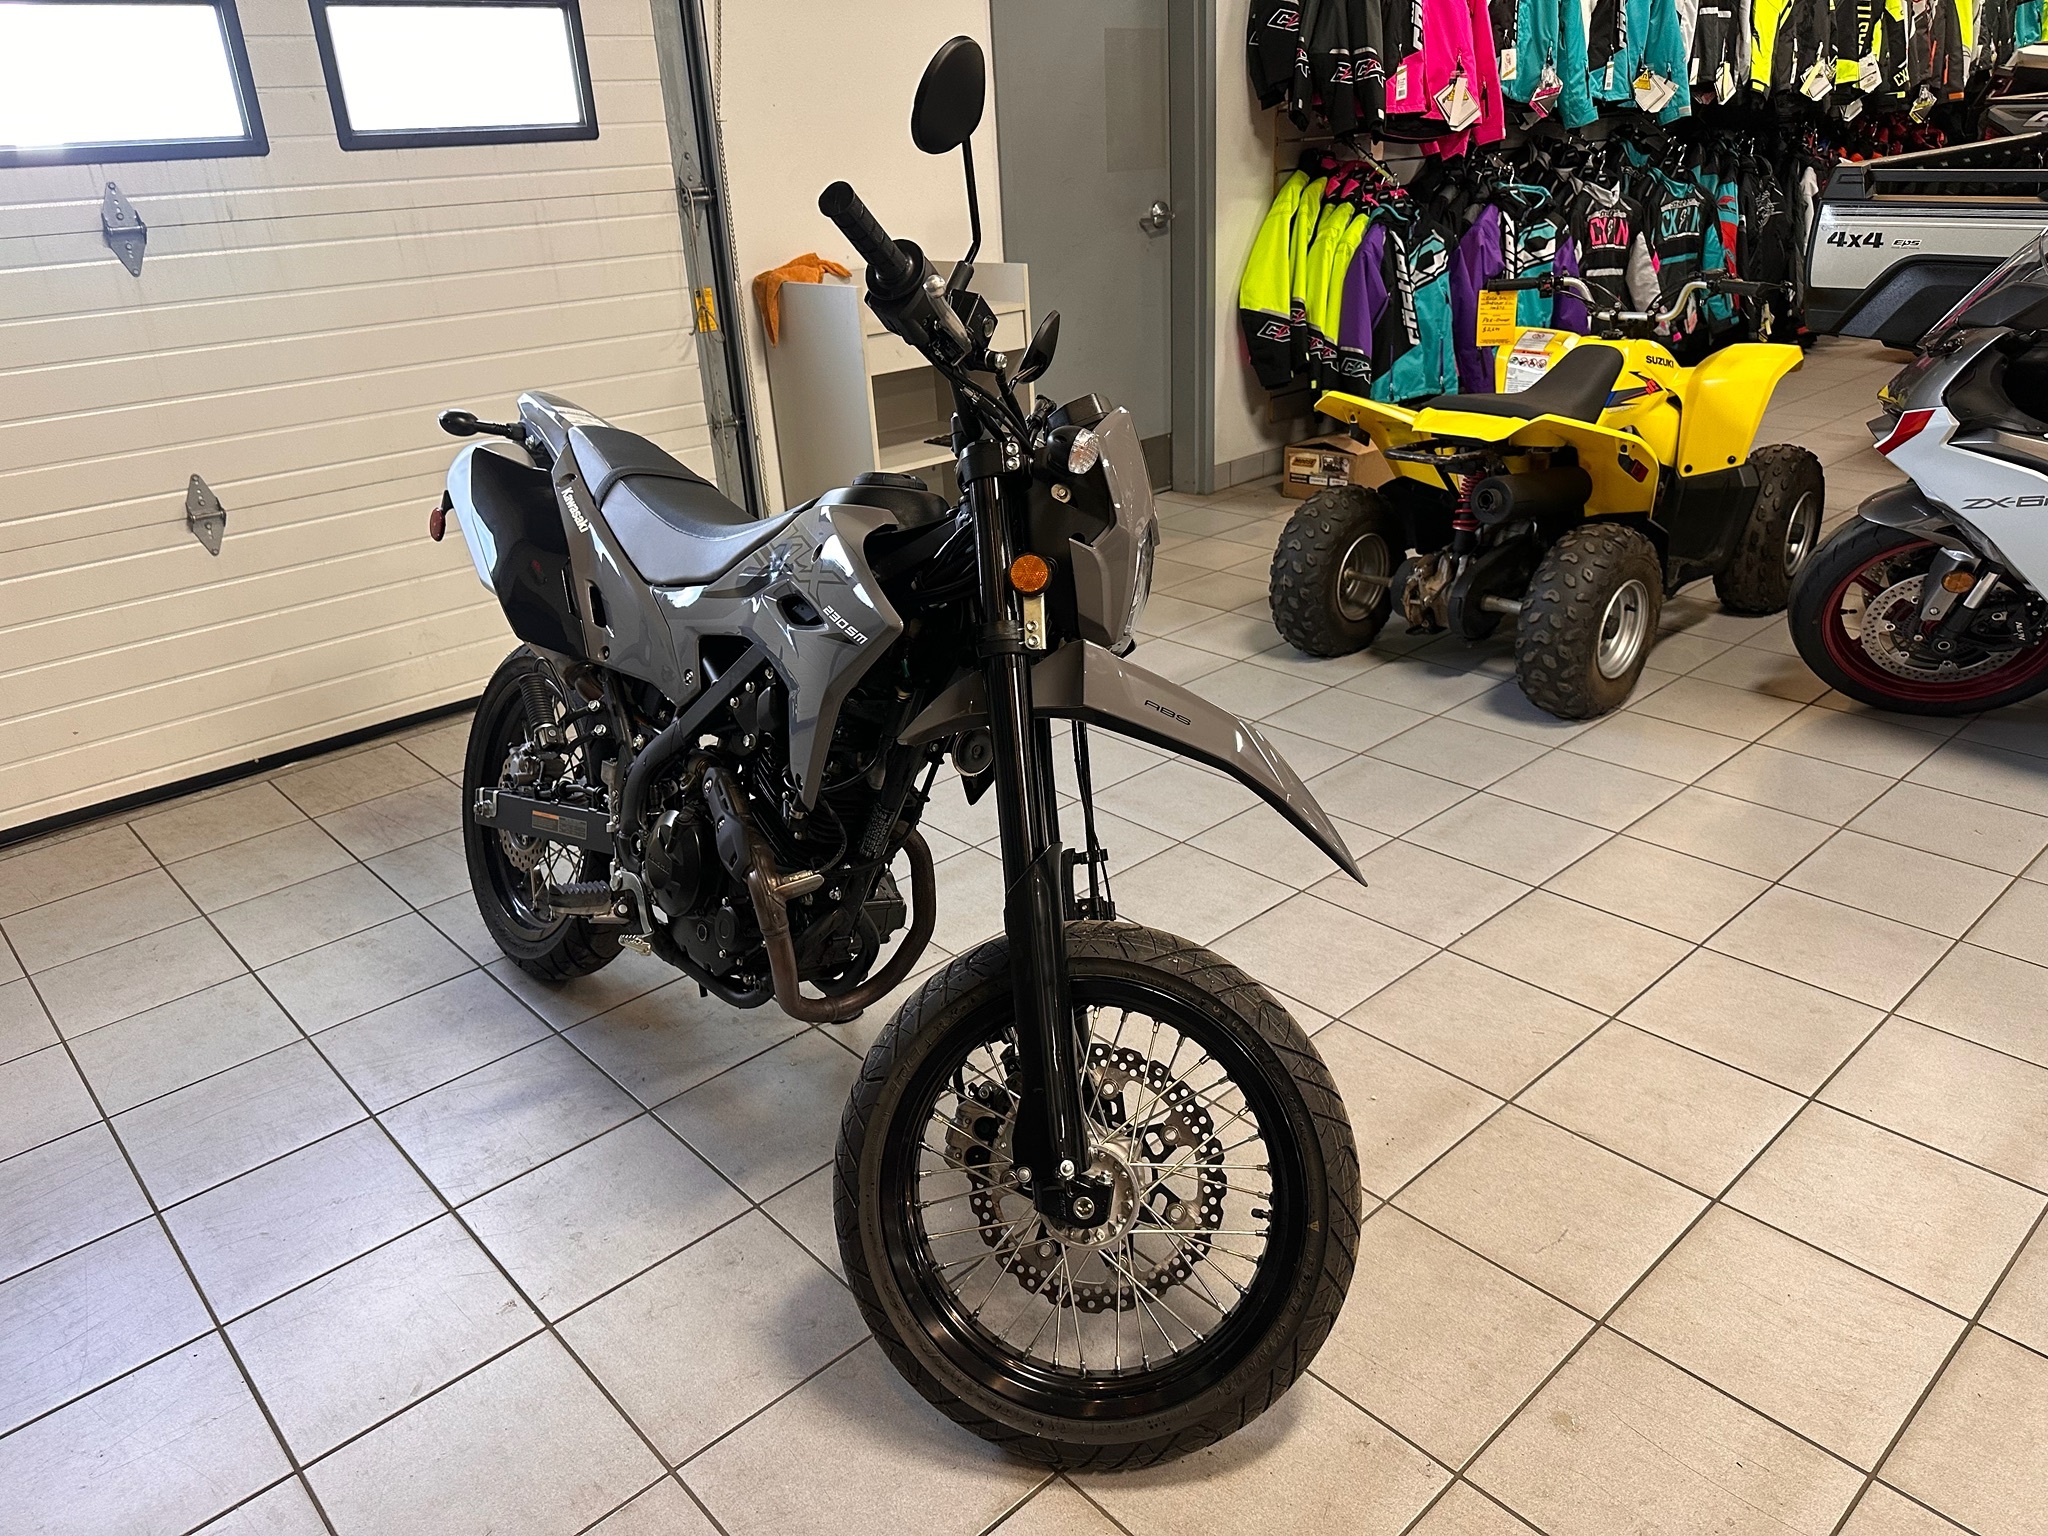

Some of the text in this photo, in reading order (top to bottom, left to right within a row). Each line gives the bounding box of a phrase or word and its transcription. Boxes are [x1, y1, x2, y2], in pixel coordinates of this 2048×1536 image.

[1826, 231, 1884, 248] 4x4
[1645, 355, 1675, 368] SUZUKI
[561, 486, 591, 534] Kawasaki
[1144, 699, 1192, 726] ABS
